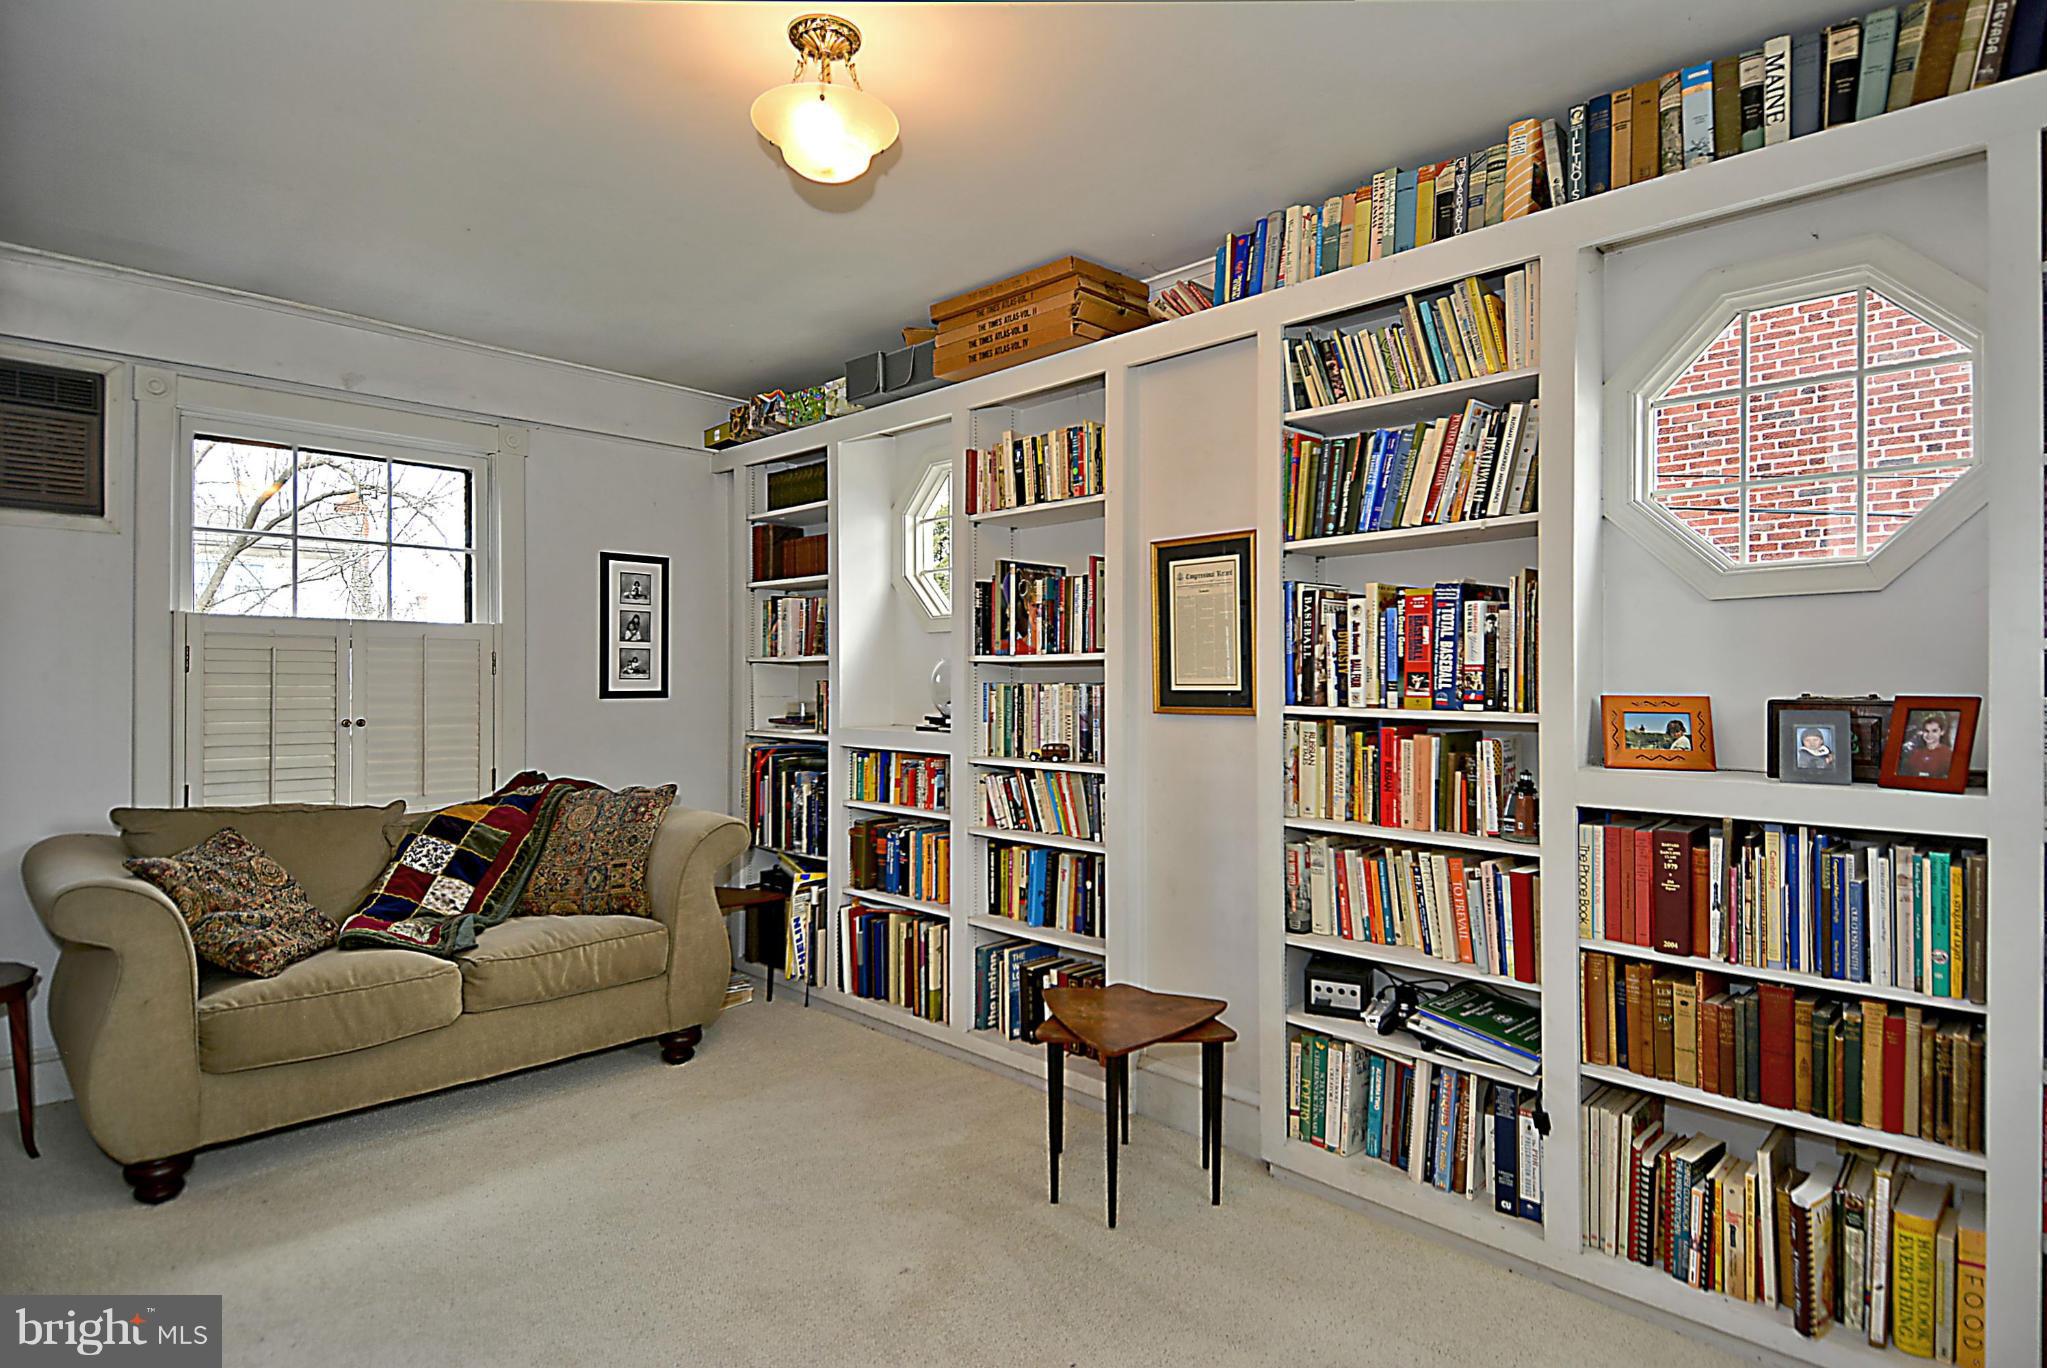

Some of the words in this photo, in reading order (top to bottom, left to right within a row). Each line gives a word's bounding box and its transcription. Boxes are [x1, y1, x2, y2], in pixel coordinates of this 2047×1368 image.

[1985, 2, 2008, 55] NEVADA
[1765, 50, 1785, 127] MAINE
[1571, 130, 1581, 199] ILLINOIS
[978, 321, 987, 332] THE
[988, 317, 1002, 329] TIMES
[968, 338, 977, 348] THE
[979, 333, 993, 346] TIMES
[968, 353, 977, 363] THE
[979, 349, 993, 361] TIMES
[1447, 414, 1462, 445] PUNTOS
[1508, 416, 1517, 438] RUSSIAN
[1444, 445, 1453, 455] DE
[1435, 456, 1450, 486] PARTIDA
[1473, 437, 1497, 502] DEATHWATCH
[1493, 473, 1504, 503] MINIATURES
[1303, 596, 1312, 659] BASEBALL
[1441, 607, 1454, 637] TOTAL
[1338, 631, 1349, 673] DYNASTY
[1414, 616, 1423, 660] BASEBALL
[1351, 659, 1361, 672] BALL
[1351, 674, 1361, 688] FOUR
[1438, 641, 1453, 690] BASEBALL
[1579, 846, 1590, 862] The
[1769, 850, 1777, 889] Cambridge
[1453, 881, 1462, 897] TO
[1579, 864, 1590, 896] Phone
[1455, 899, 1468, 941] PREVAIL
[1579, 898, 1590, 924] Book
[1012, 952, 1025, 960] THE
[1663, 940, 1678, 949] 2004
[1300, 1078, 1311, 1124] POETRY
[1441, 1073, 1453, 1126] ANTIQUES
[1918, 1239, 1930, 1273] HOW
[1899, 1234, 1914, 1338] EVERYTHING
[1918, 1279, 1930, 1297] TO
[1918, 1302, 1930, 1340] COOK
[1963, 1274, 1984, 1351] FOOD
